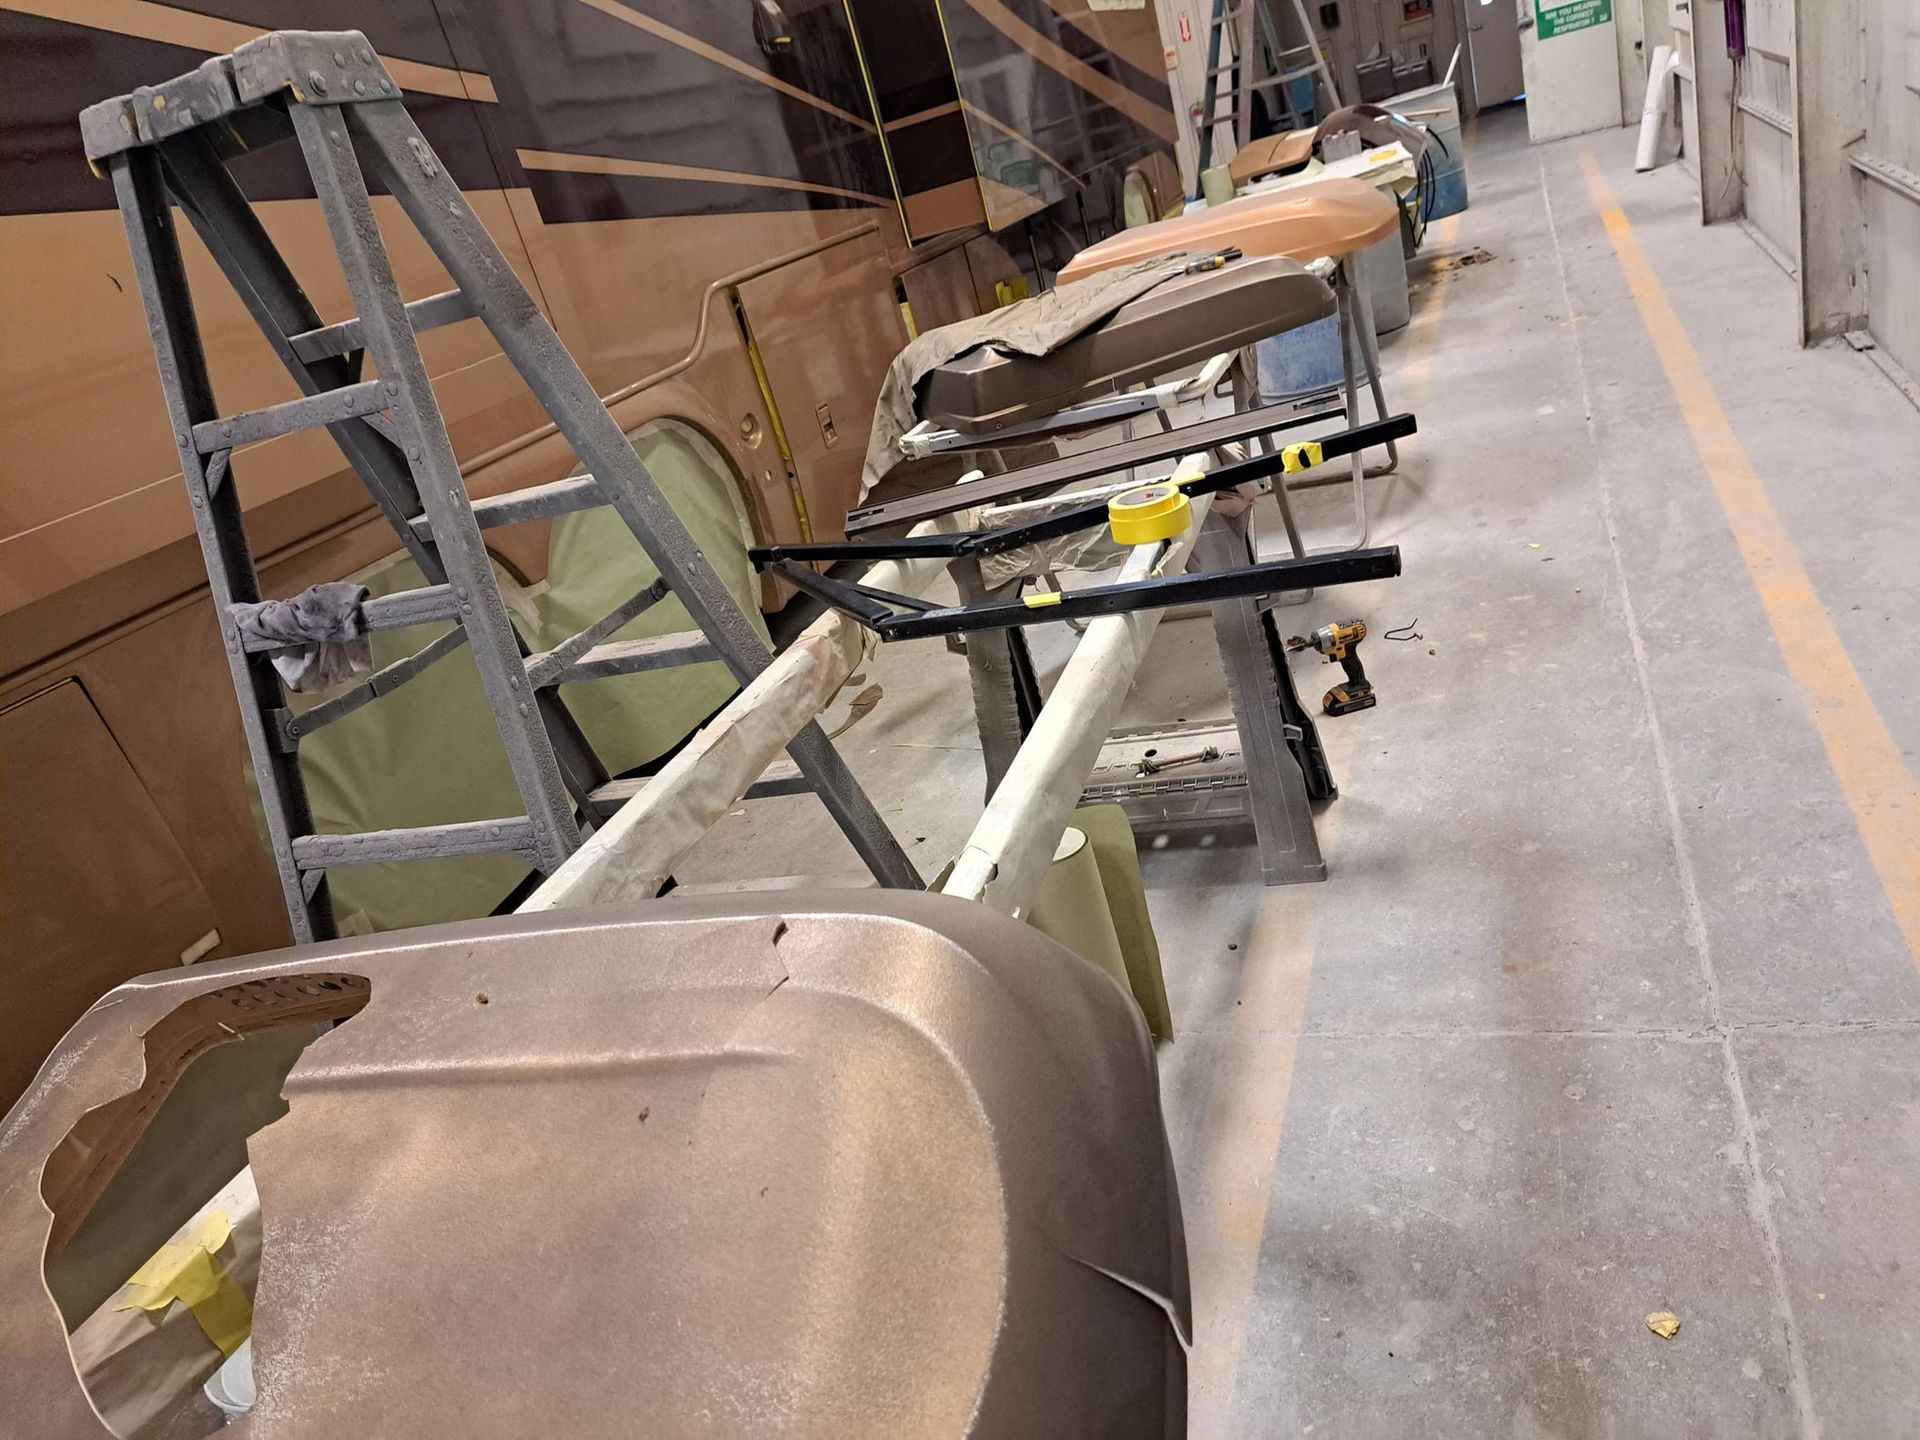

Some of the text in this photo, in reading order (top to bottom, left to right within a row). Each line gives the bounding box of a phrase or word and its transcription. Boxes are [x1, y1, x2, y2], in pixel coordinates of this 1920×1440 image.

[1554, 9, 1594, 26] THE CORRECT
[1559, 6, 1572, 16] YOU
